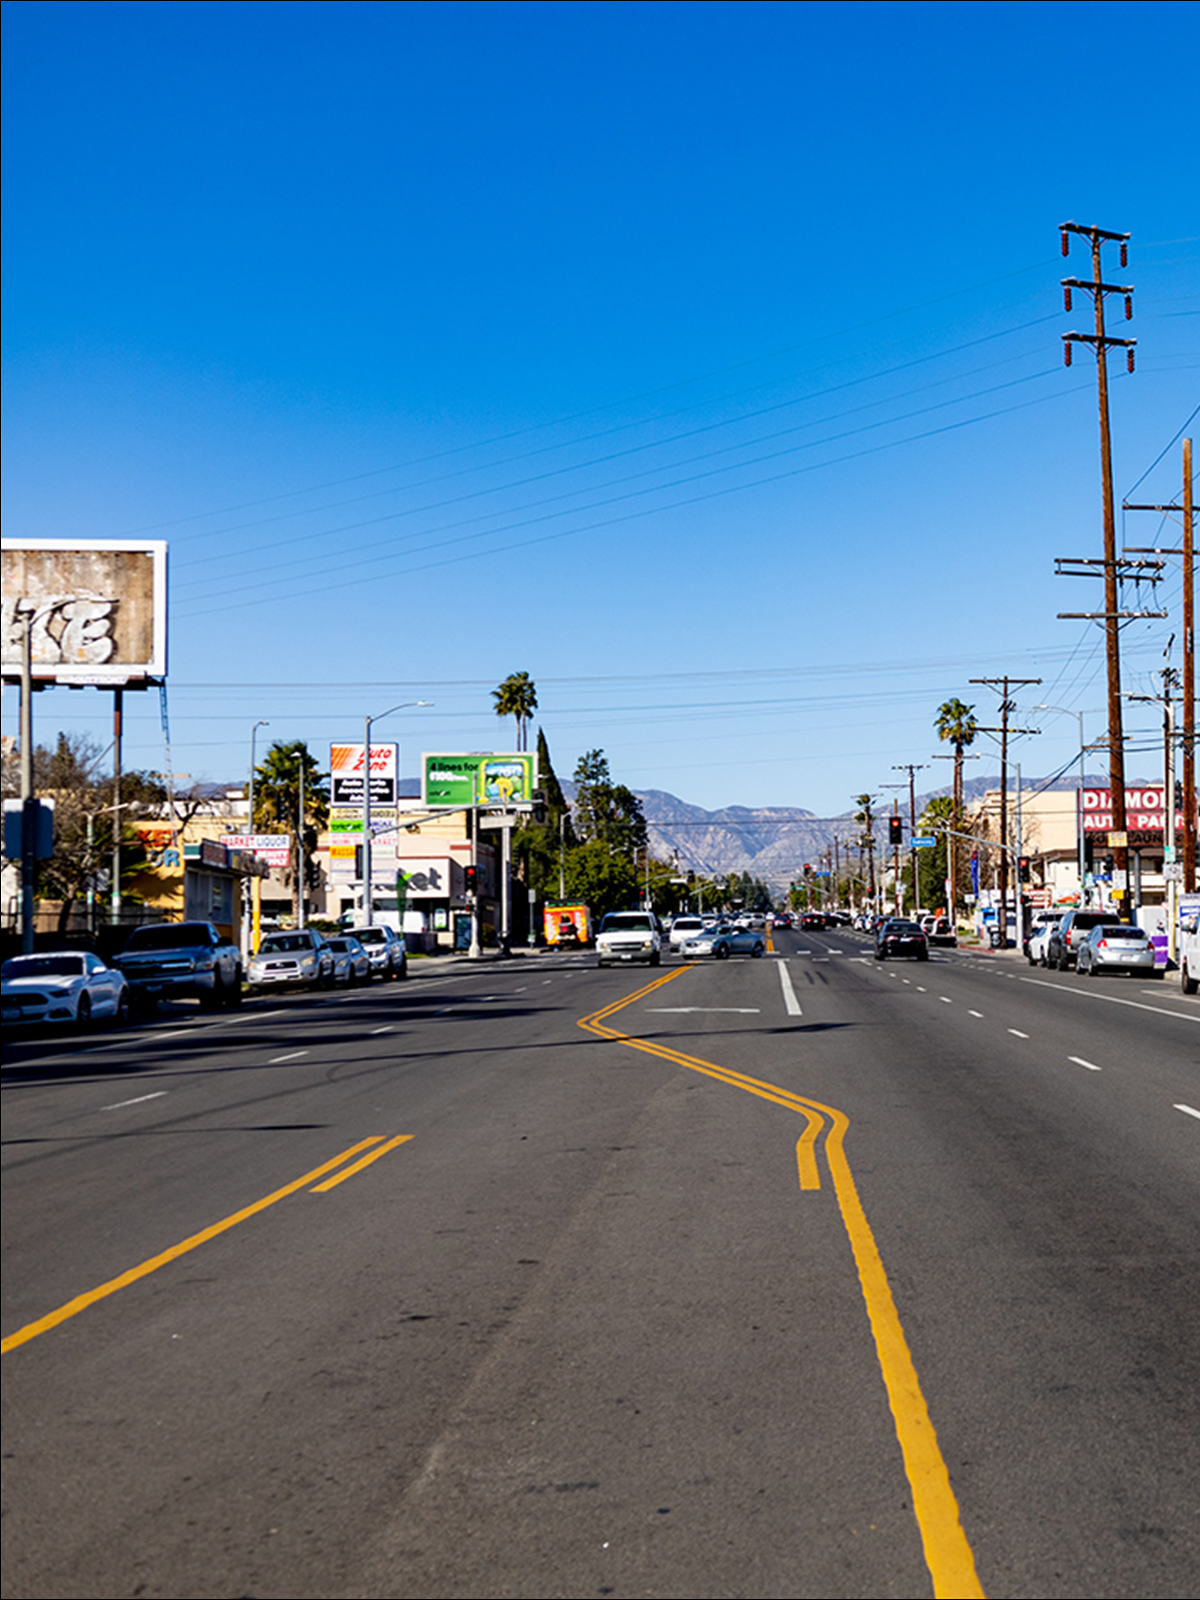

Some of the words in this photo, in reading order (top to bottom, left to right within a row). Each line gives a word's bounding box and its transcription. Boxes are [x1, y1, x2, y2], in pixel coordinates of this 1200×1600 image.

[352, 759, 388, 771] Zne
[430, 763, 437, 771] 4
[256, 836, 287, 847] LIQUOR
